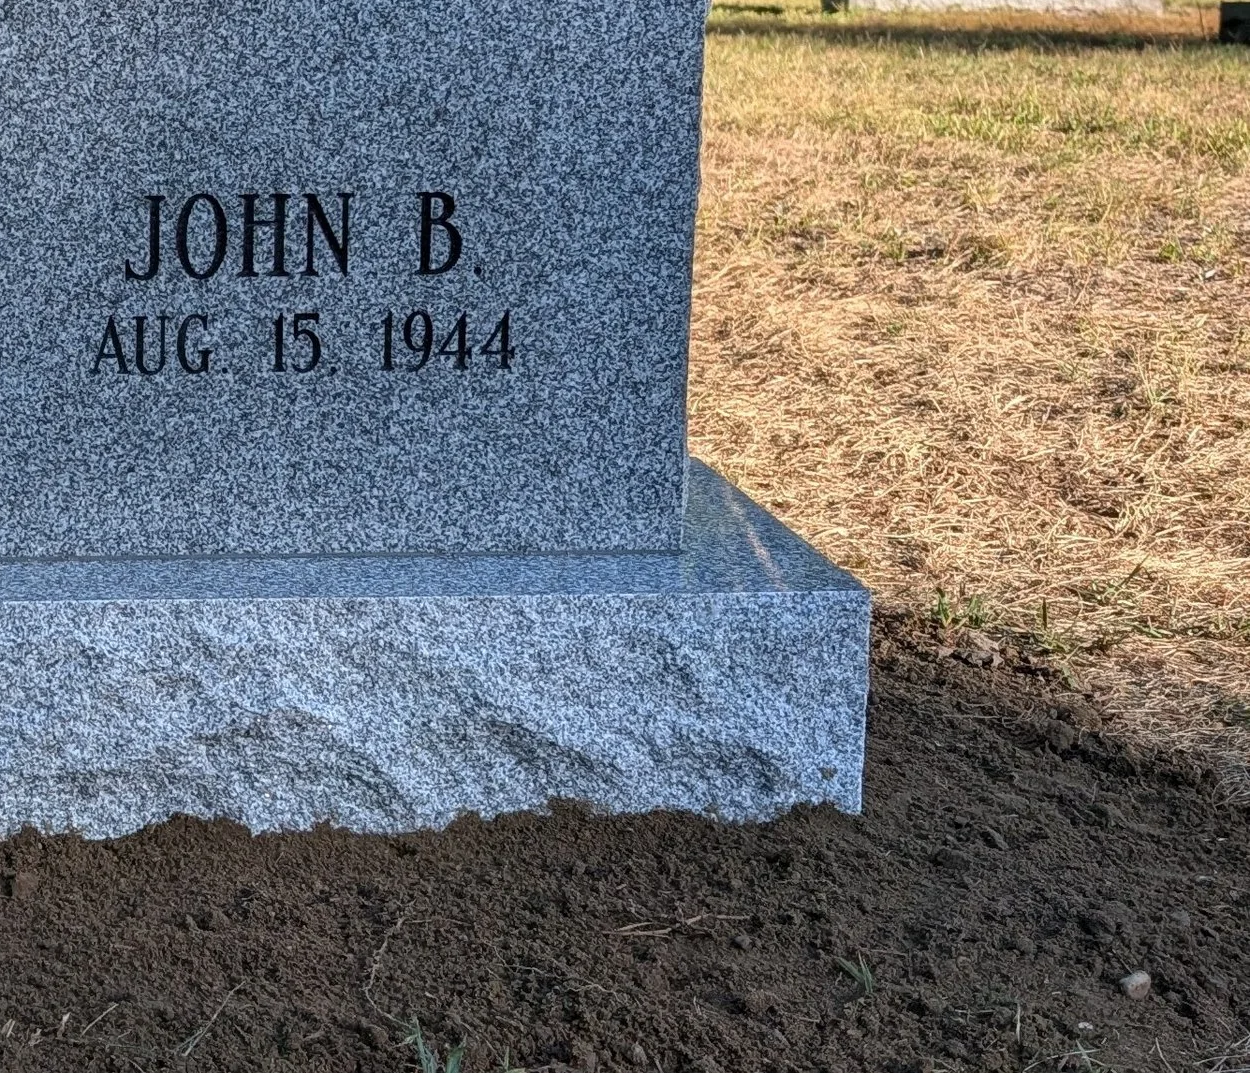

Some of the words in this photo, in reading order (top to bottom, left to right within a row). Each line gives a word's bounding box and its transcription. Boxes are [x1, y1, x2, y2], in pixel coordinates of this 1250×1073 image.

[124, 192, 352, 281] JOHN
[415, 191, 483, 275] B.
[92, 313, 230, 374] AUG.
[380, 309, 516, 372] 1944
